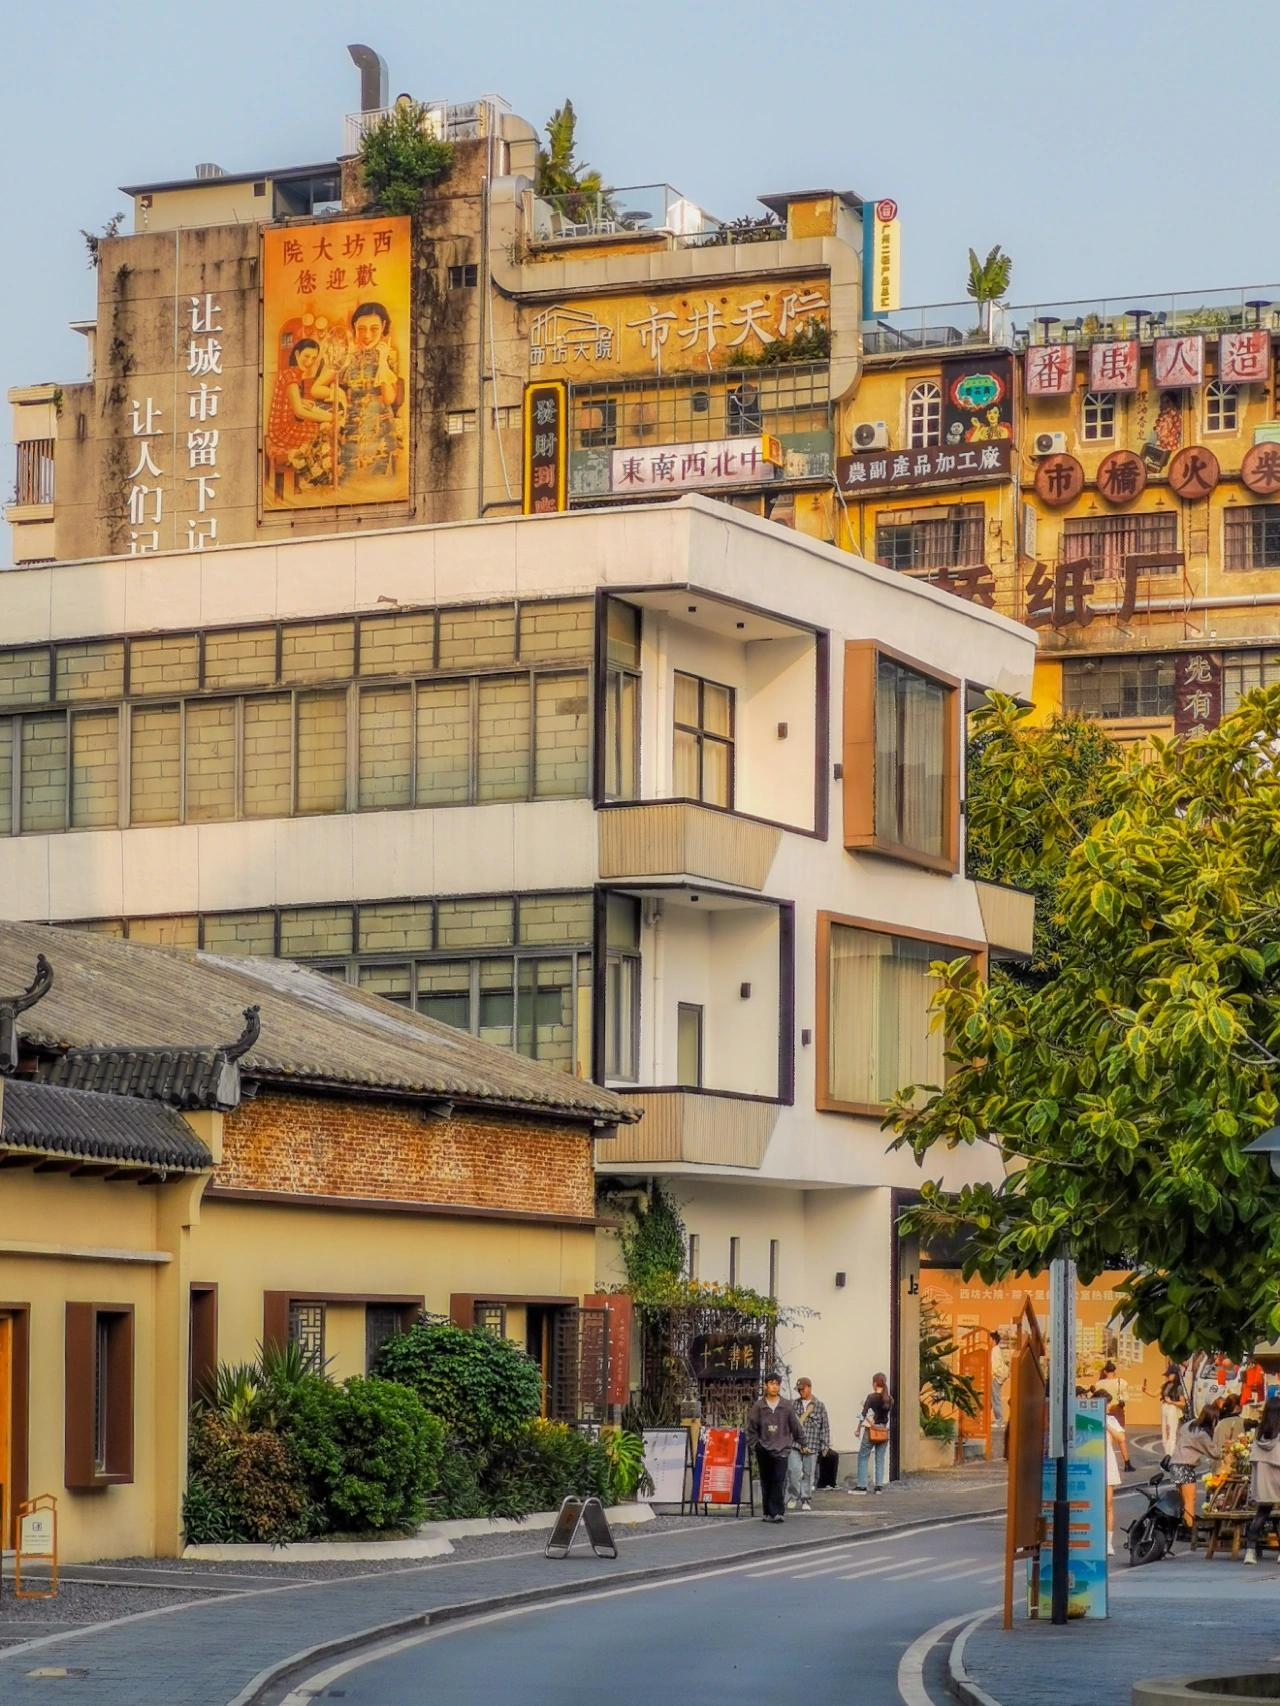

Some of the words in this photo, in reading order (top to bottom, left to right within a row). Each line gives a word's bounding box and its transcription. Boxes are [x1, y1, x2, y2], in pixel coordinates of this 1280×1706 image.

[529, 333, 613, 366] 西坊大院
[1033, 335, 1260, 391] 番禺人造
[618, 445, 764, 485] 東南西北中
